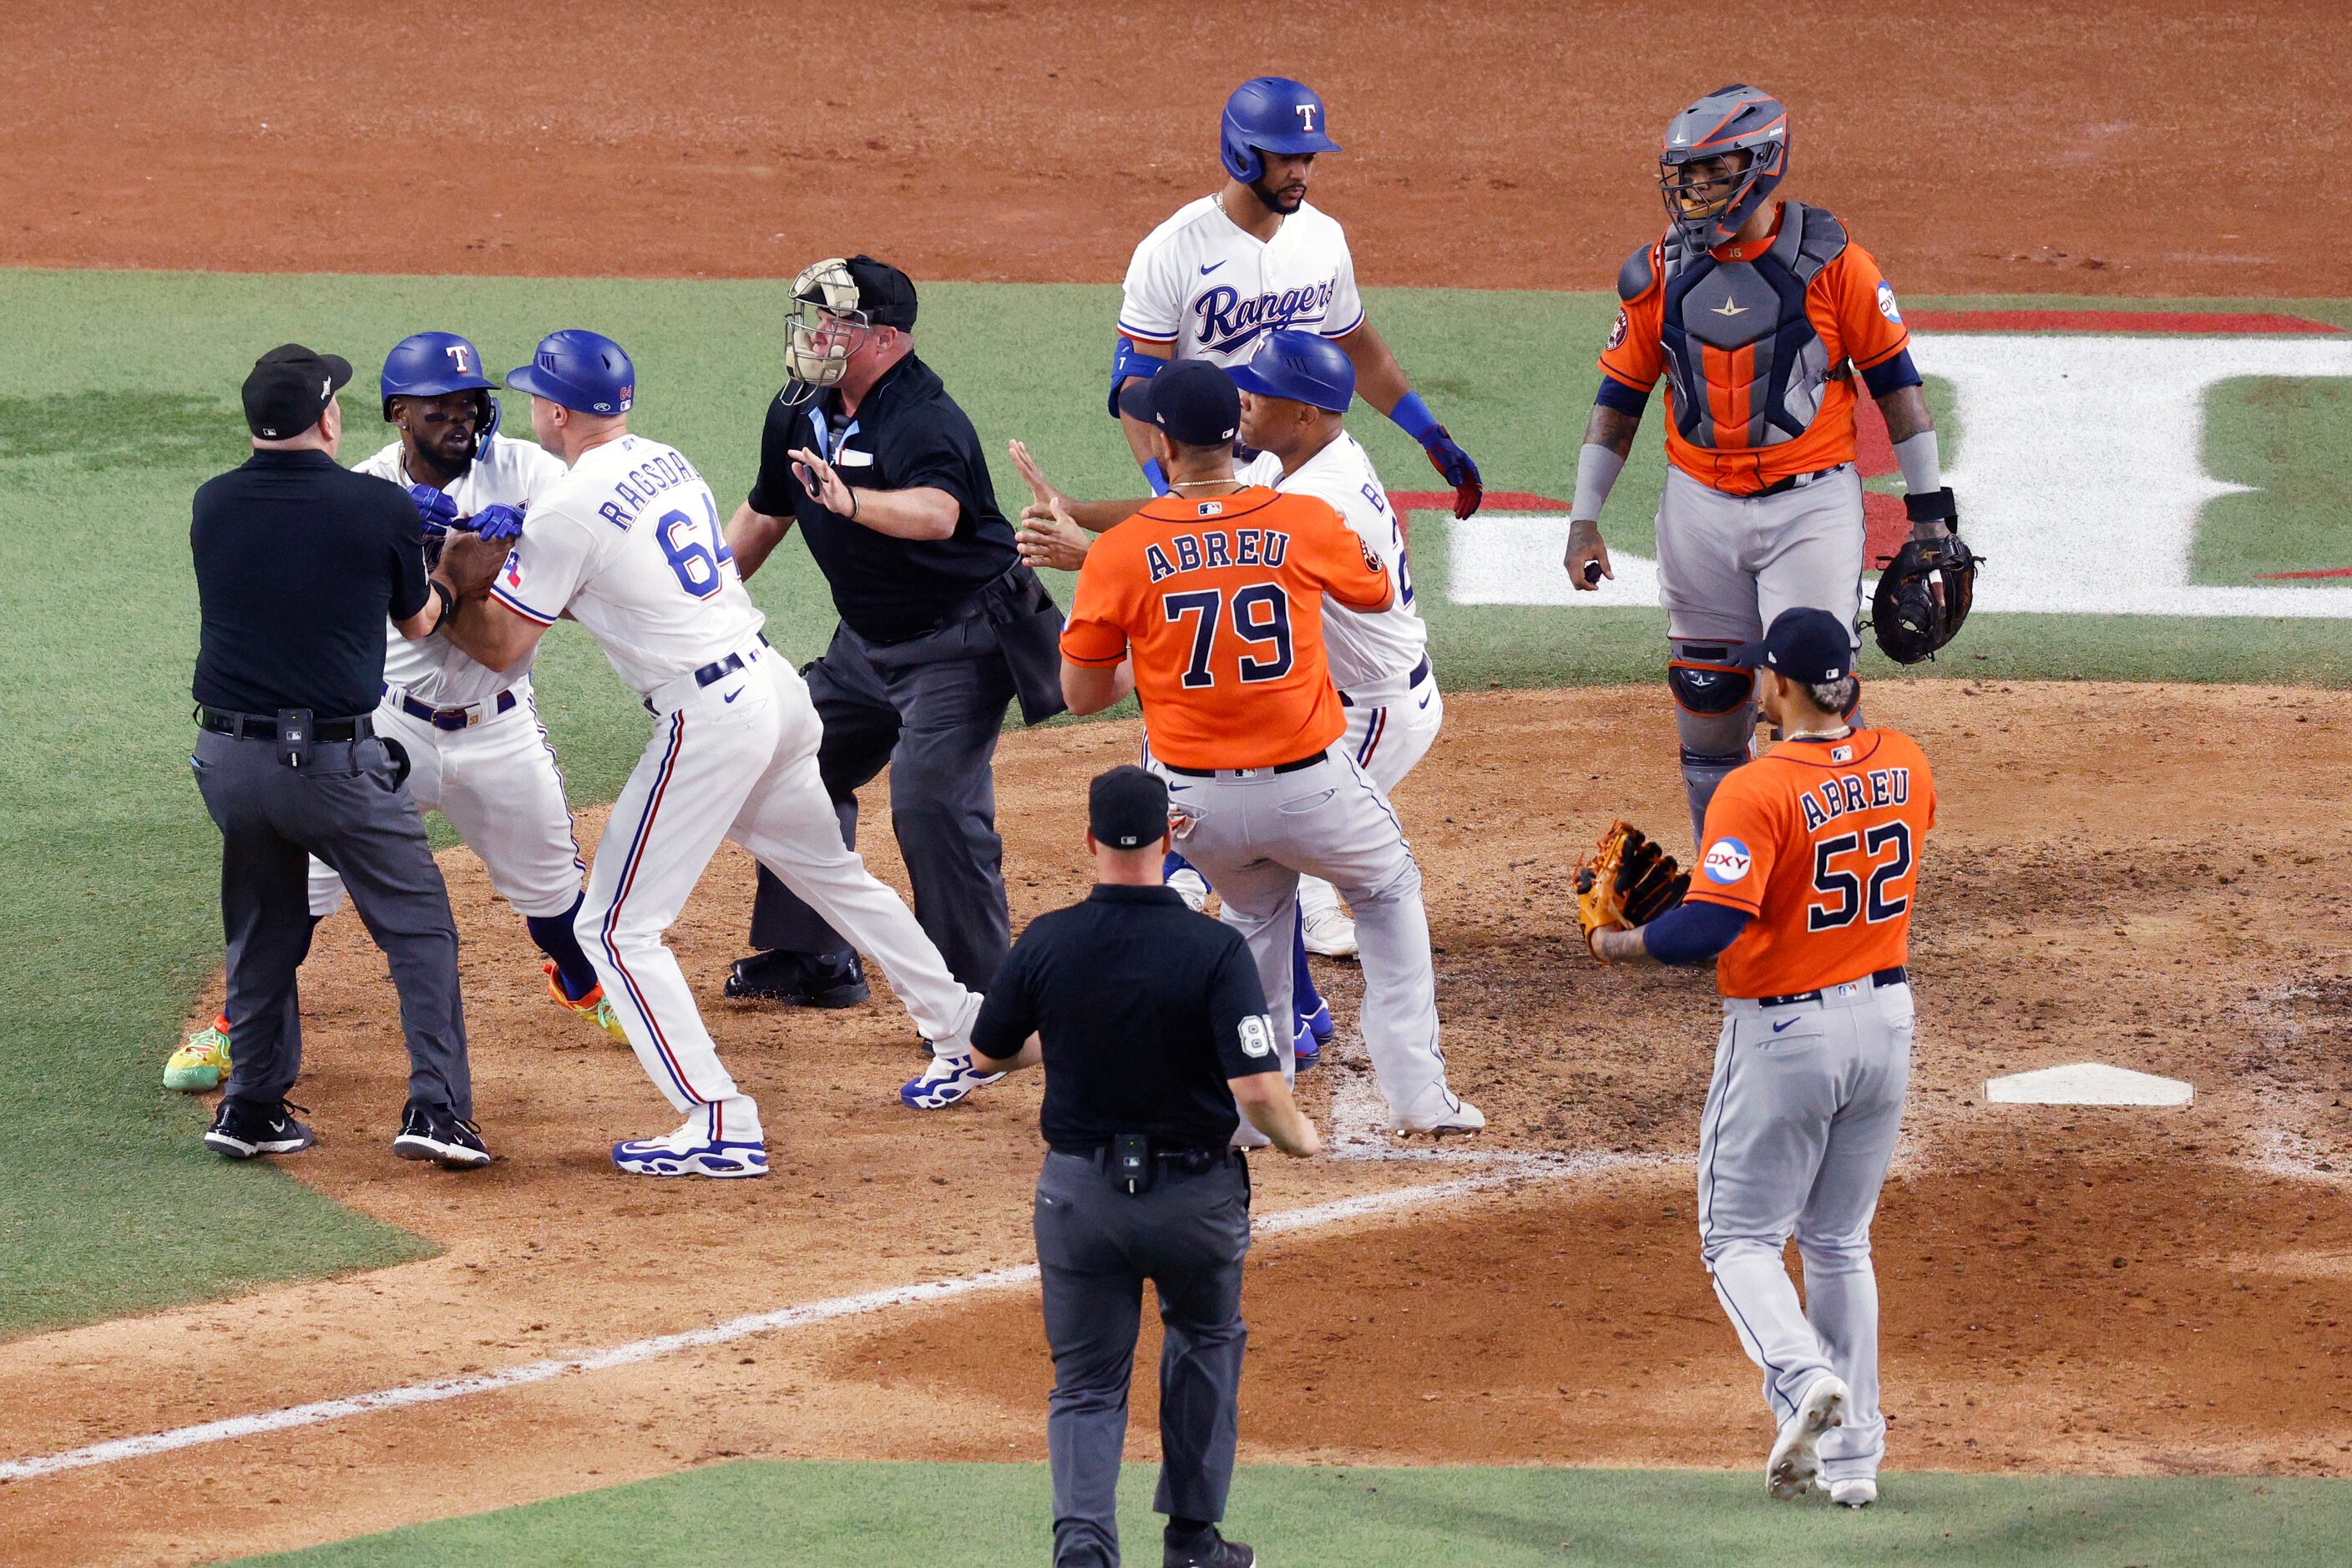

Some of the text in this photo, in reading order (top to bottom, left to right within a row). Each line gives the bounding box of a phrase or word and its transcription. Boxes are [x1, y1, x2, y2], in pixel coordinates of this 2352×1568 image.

[1295, 104, 1317, 133] T
[1193, 276, 1336, 345] Rangers
[445, 345, 469, 374] T
[1145, 529, 1290, 584] ABREU
[1162, 581, 1294, 690] 79
[1799, 767, 1909, 833] ABREU
[1706, 853, 1749, 870] OXY
[1807, 818, 1913, 933] 52
